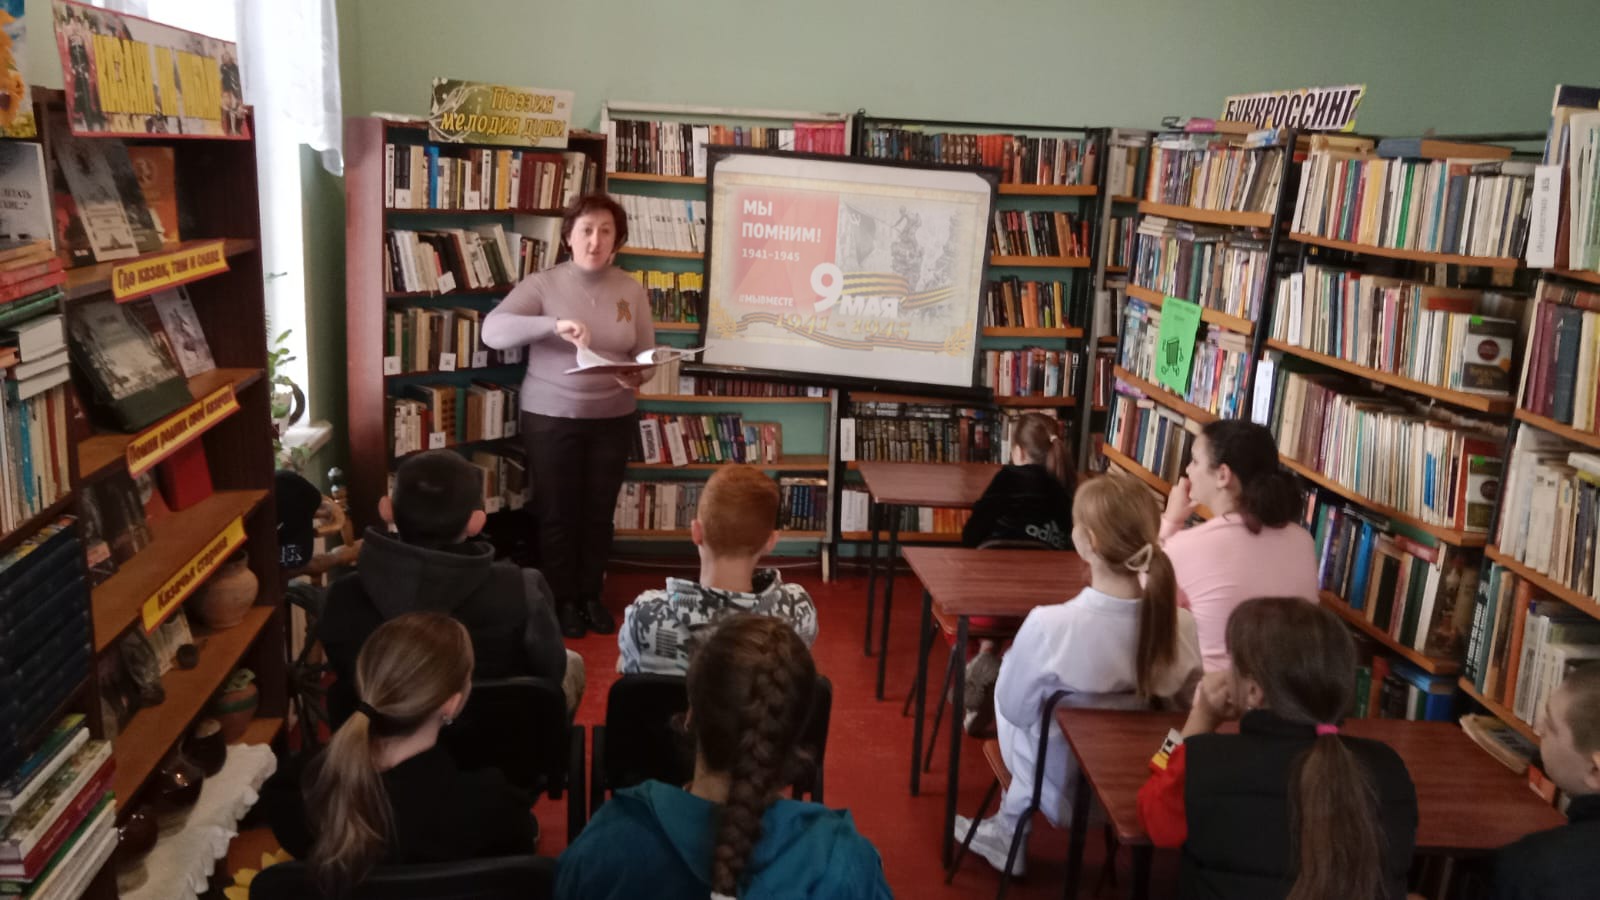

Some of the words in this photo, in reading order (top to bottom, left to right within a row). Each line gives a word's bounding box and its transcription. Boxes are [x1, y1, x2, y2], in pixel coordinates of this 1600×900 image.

[491, 86, 554, 113] Поэзия
[1225, 89, 1361, 130] БУККРОССИНГ
[520, 118, 565, 146] души
[743, 200, 773, 217] МЫ
[742, 222, 822, 243] ПОМНИМ!
[742, 248, 800, 262] 1941-1945
[118, 268, 136, 291] Где
[138, 263, 171, 284] казак,
[810, 262, 844, 312] 9
[839, 294, 899, 318] МАЯ
[739, 294, 793, 307] #МЫВМЕСТЕ
[775, 312, 829, 335] 1941
[851, 318, 912, 338] 1945
